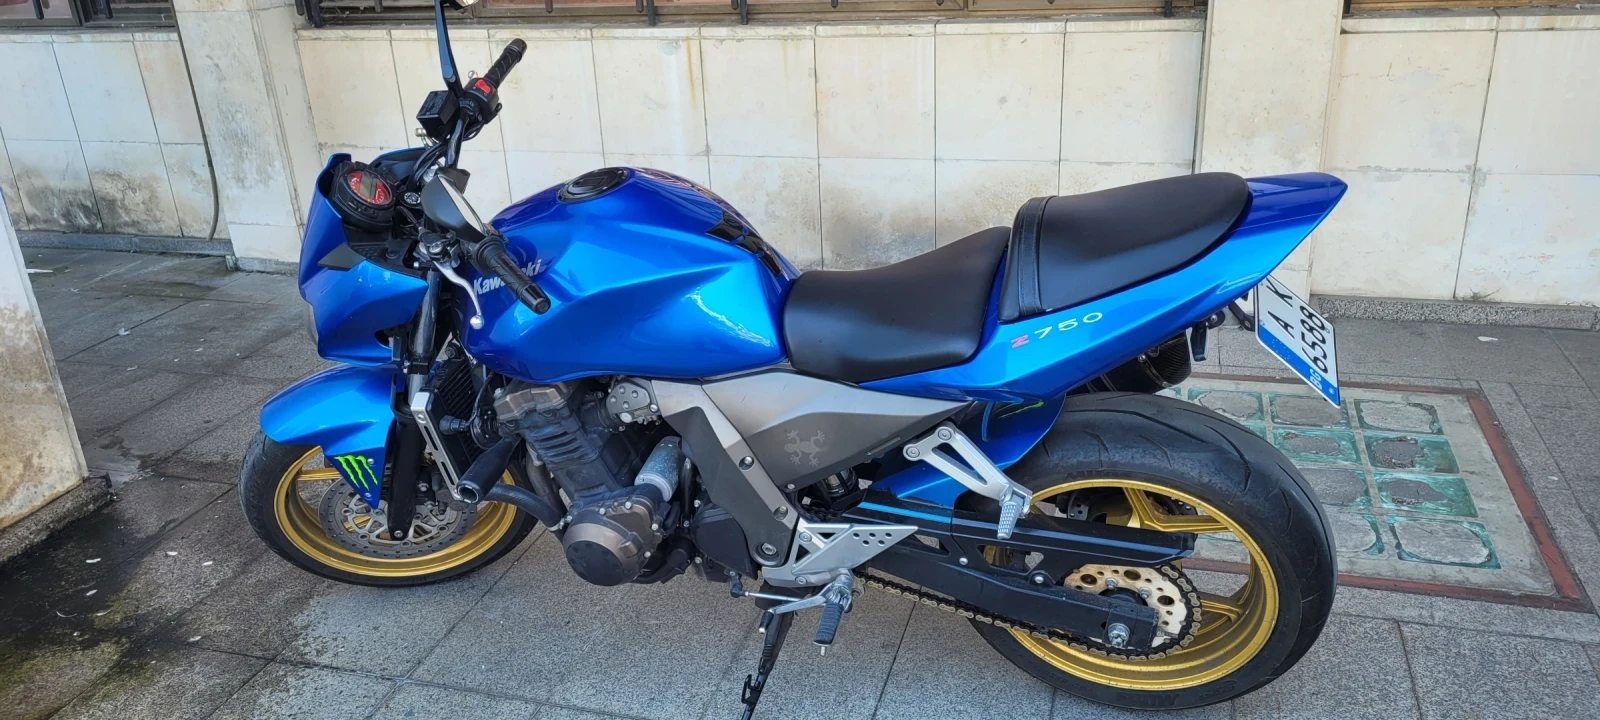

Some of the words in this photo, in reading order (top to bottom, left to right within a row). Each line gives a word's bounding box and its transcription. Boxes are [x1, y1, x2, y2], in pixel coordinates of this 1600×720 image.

[473, 258, 542, 295] Kawki
[1265, 277, 1293, 308] K
[1267, 311, 1295, 340] A
[1299, 305, 1329, 374] 6588
[1309, 368, 1323, 390] BG
